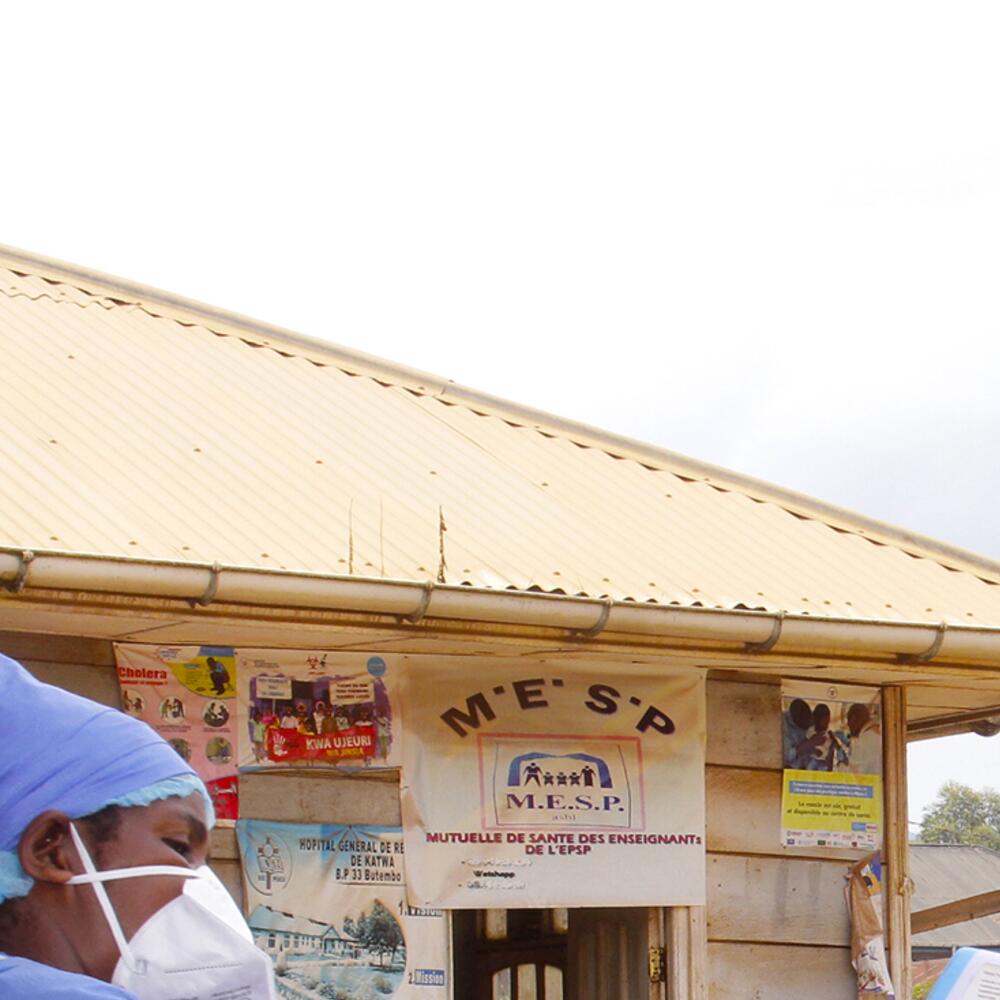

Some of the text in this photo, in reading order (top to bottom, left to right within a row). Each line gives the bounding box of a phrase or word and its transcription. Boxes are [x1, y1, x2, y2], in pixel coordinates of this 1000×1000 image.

[119, 667, 167, 679] Cholera
[305, 738, 332, 750] KWA
[333, 735, 371, 748] UJEURI
[507, 794, 624, 812] M.E.S.P.
[426, 832, 502, 844] MUTUELLE
[506, 833, 525, 844] DE
[528, 833, 573, 844] SANTE
[580, 834, 605, 844] DES
[338, 840, 377, 853] GENERAL
[380, 841, 391, 854] DE
[525, 845, 592, 856] DE L'EPSP
[351, 855, 395, 868] DE KATWA
[352, 869, 362, 881] 33
[364, 869, 402, 882] Butembo
